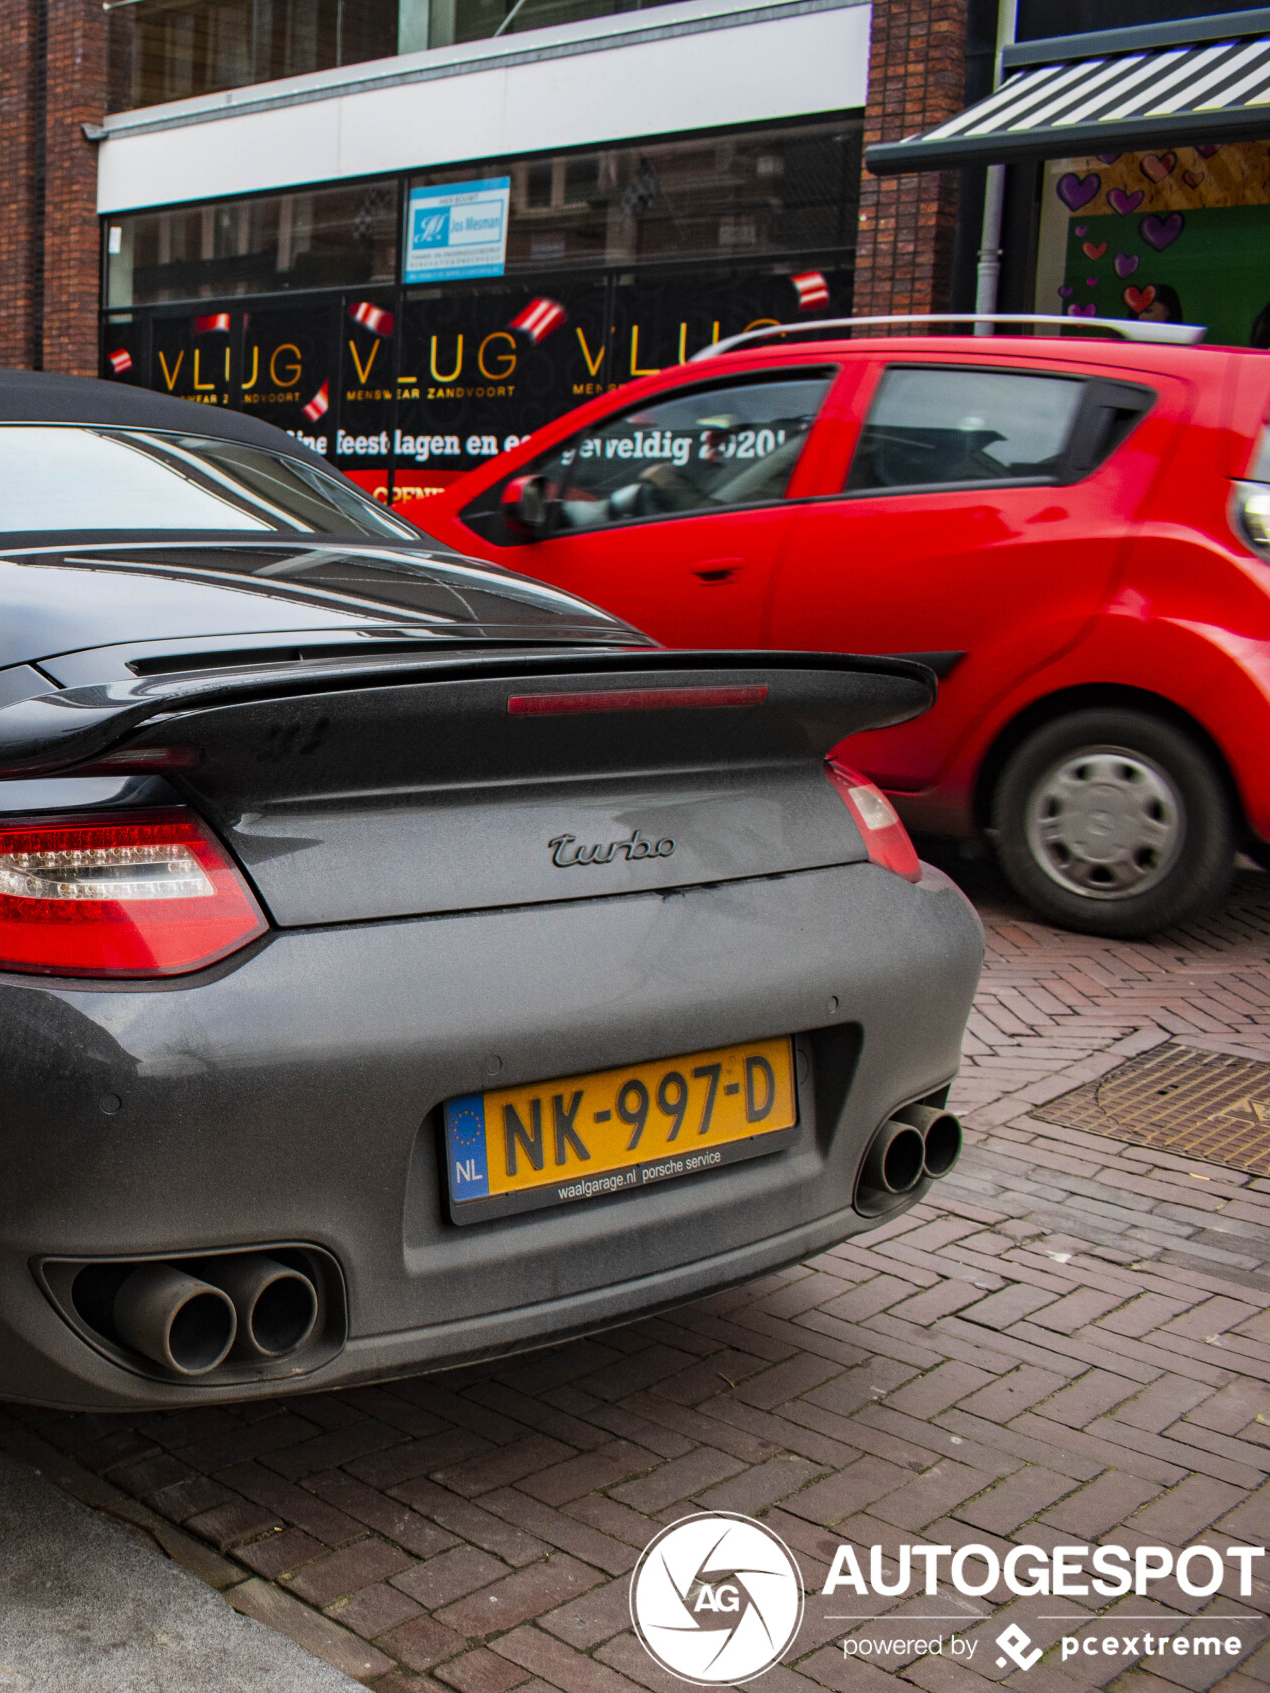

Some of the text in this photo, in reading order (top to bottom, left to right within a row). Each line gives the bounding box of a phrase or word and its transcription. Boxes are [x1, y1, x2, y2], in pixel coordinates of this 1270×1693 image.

[427, 385, 516, 400] ZANDVOORT
[466, 436, 499, 455] en
[547, 829, 677, 868] Turbo
[455, 1054, 777, 1184] NL NK-997-D
[558, 1149, 722, 1201] waalgarage.nl porsche service
